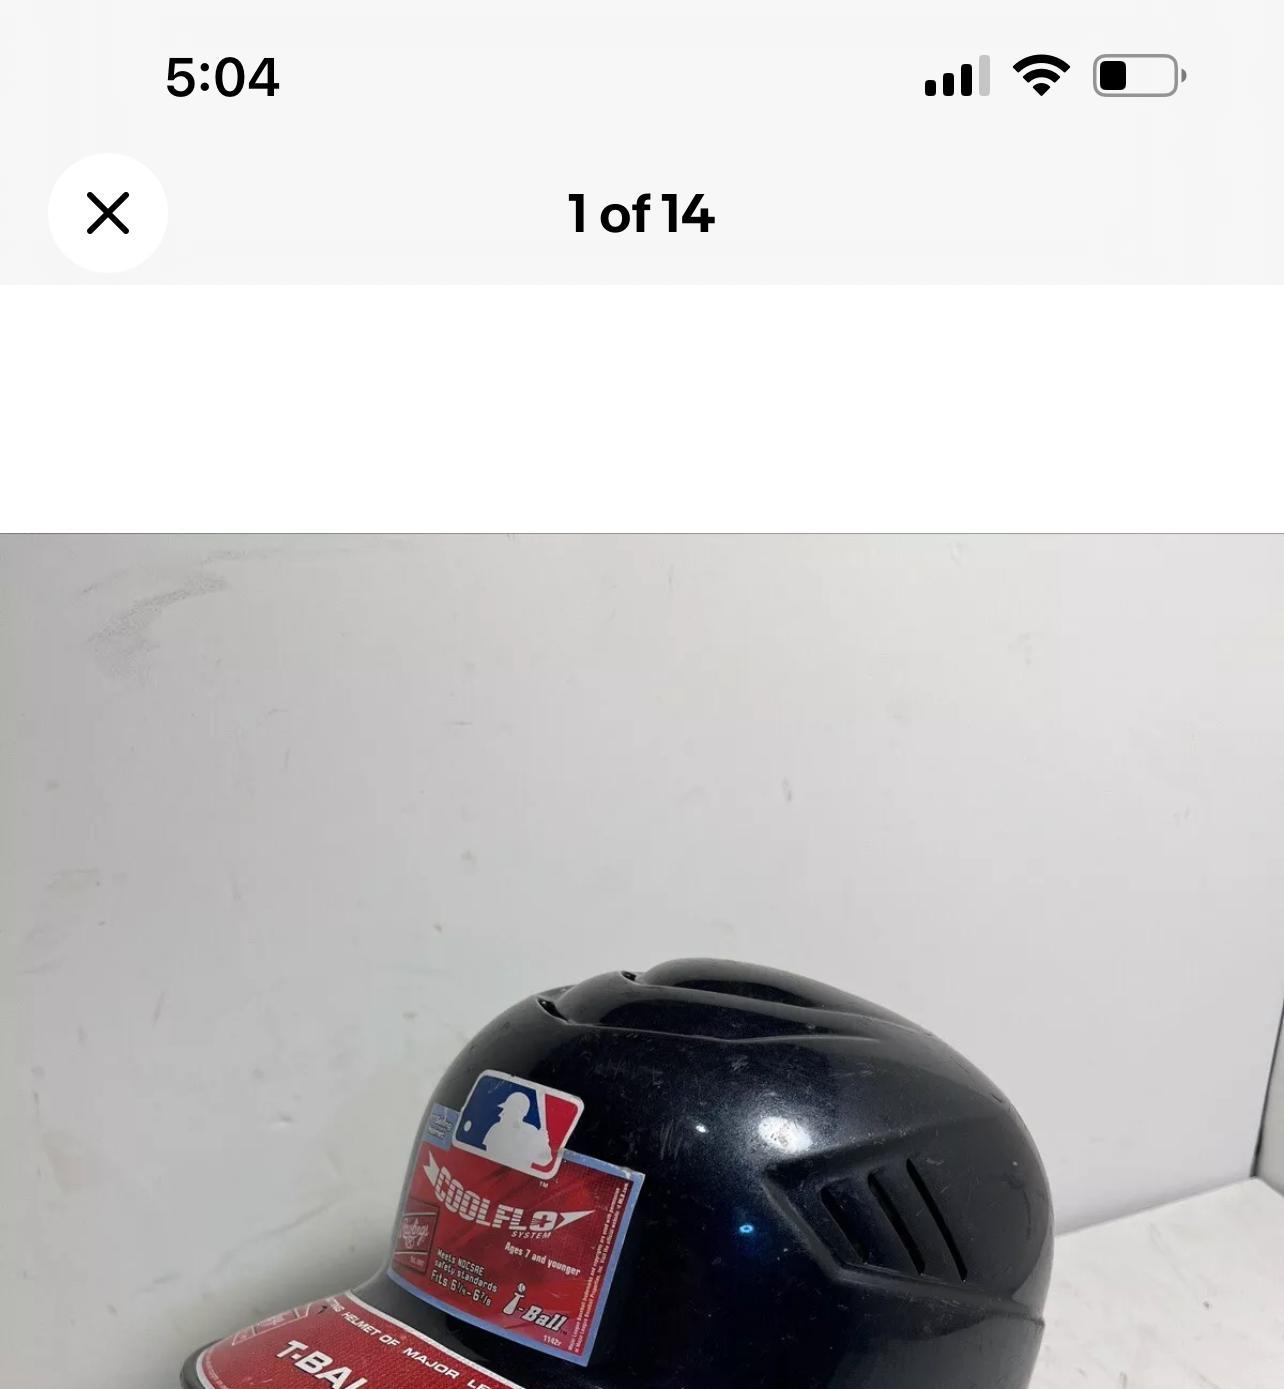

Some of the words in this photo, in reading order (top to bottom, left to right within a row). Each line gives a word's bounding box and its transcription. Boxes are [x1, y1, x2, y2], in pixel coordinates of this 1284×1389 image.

[511, 1230, 552, 1240] SYSTEM
[437, 1248, 456, 1264] Meets
[458, 1256, 485, 1276] NOCSAE
[505, 1241, 526, 1258] Ages
[525, 1248, 531, 1257] 7
[532, 1253, 546, 1265] and
[547, 1258, 581, 1276] younger
[430, 1269, 449, 1287] Fits
[434, 1260, 456, 1275] safety
[457, 1270, 498, 1293] standards
[341, 1311, 382, 1337] HELMET
[379, 1334, 401, 1347] OF
[403, 1347, 460, 1380] MAJOR
